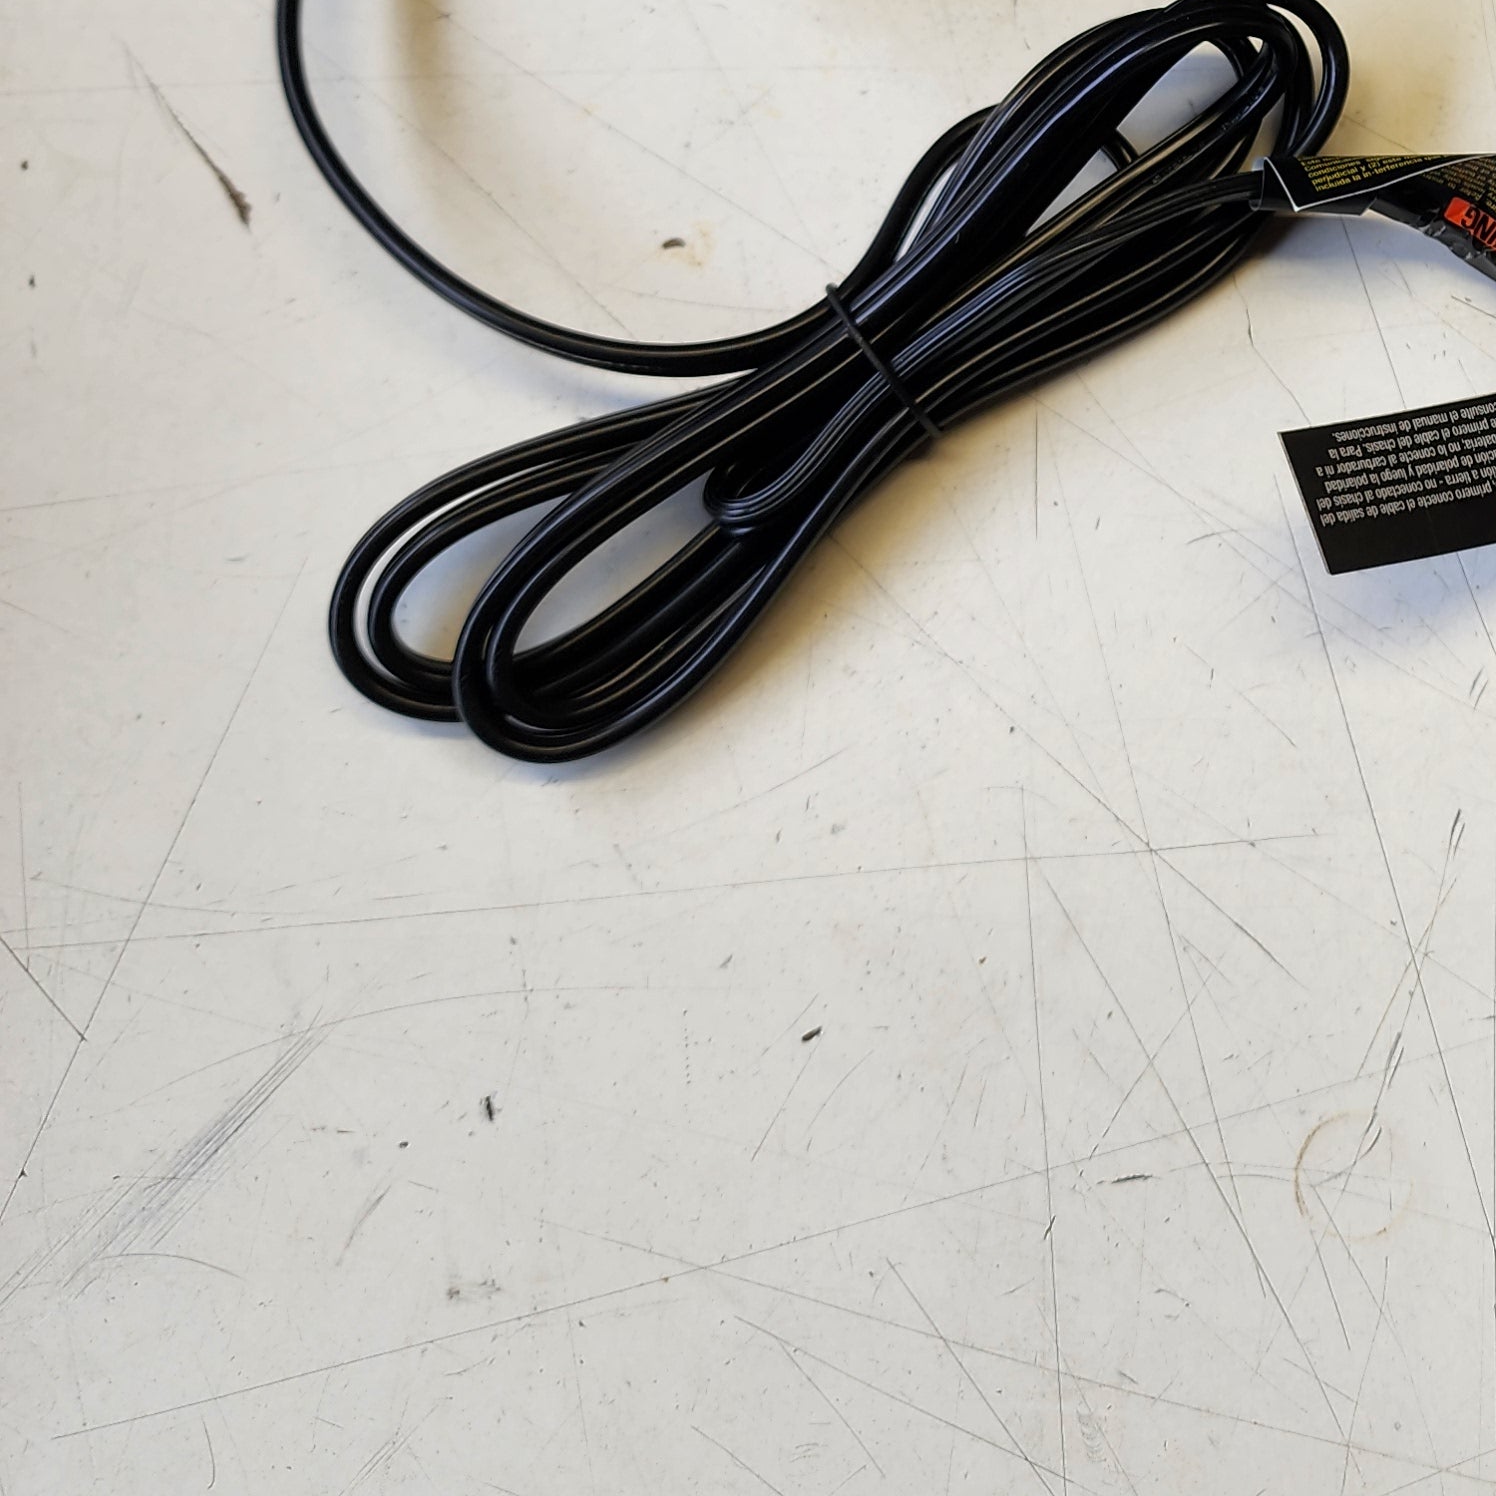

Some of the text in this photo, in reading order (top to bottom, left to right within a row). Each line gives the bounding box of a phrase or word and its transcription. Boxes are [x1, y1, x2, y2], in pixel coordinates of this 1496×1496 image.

[1411, 411, 1448, 431] manual
[1447, 409, 1459, 423] el
[1330, 420, 1398, 446] instrucciones.
[1397, 418, 1412, 433] de
[1449, 416, 1490, 439] primero
[1412, 428, 1440, 447] cable
[1439, 426, 1451, 441] el
[1361, 437, 1396, 456] chasis.
[1396, 434, 1413, 450] del
[1447, 440, 1461, 453] no
[1326, 447, 1339, 461] la
[1337, 443, 1362, 460] Para
[1397, 445, 1437, 465] conecte
[1436, 443, 1448, 457] lo
[1335, 454, 1387, 477] carburador
[1386, 452, 1398, 467] al
[1413, 454, 1460, 478] polaridad
[1459, 454, 1474, 469] de
[1314, 465, 1324, 477] a
[1323, 463, 1335, 478] ni
[1378, 464, 1407, 484] luego
[1406, 463, 1414, 477] y
[1470, 468, 1479, 479] a
[1322, 472, 1369, 494] polaridad
[1368, 472, 1381, 487] la
[1422, 477, 1437, 490] no
[1444, 470, 1471, 488] tierra
[1362, 489, 1375, 503] al
[1373, 479, 1424, 501] conectado
[1453, 479, 1492, 503] primero
[1315, 496, 1333, 511] del
[1331, 490, 1364, 509] chasis
[1405, 497, 1416, 511] el
[1416, 489, 1455, 510] conecte
[1335, 506, 1365, 524] salida
[1364, 504, 1379, 519] de
[1378, 499, 1406, 516] cable
[1319, 511, 1336, 526] del
